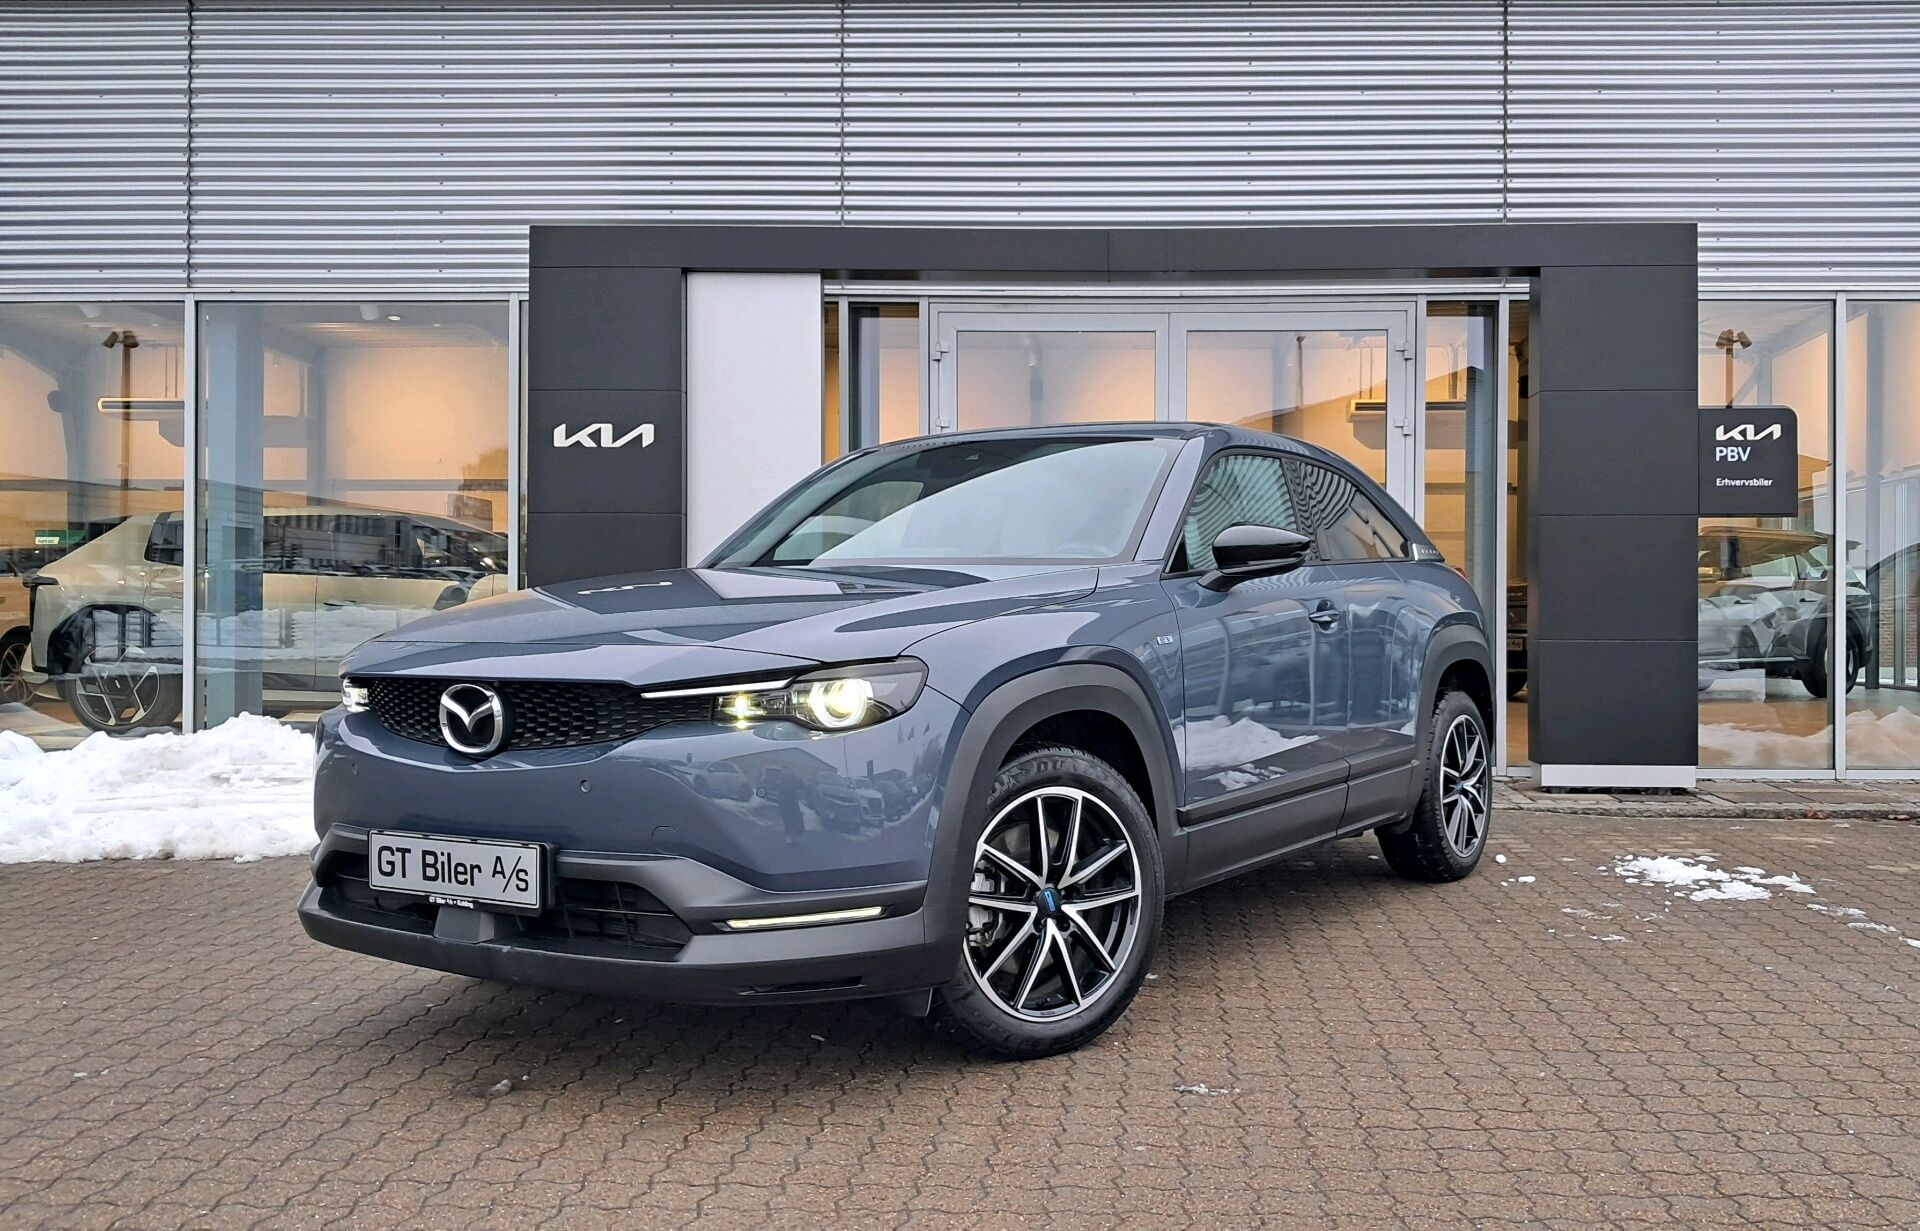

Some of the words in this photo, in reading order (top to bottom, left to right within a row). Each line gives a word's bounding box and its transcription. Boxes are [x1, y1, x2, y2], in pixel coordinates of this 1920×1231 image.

[553, 423, 655, 448] KIA
[1715, 423, 1782, 441] KIA
[1715, 446, 1752, 462] PBV
[1716, 477, 1774, 487] Erhvervsbiler
[377, 845, 412, 879] GT
[421, 849, 483, 887] Biler
[491, 855, 530, 893] A/S
